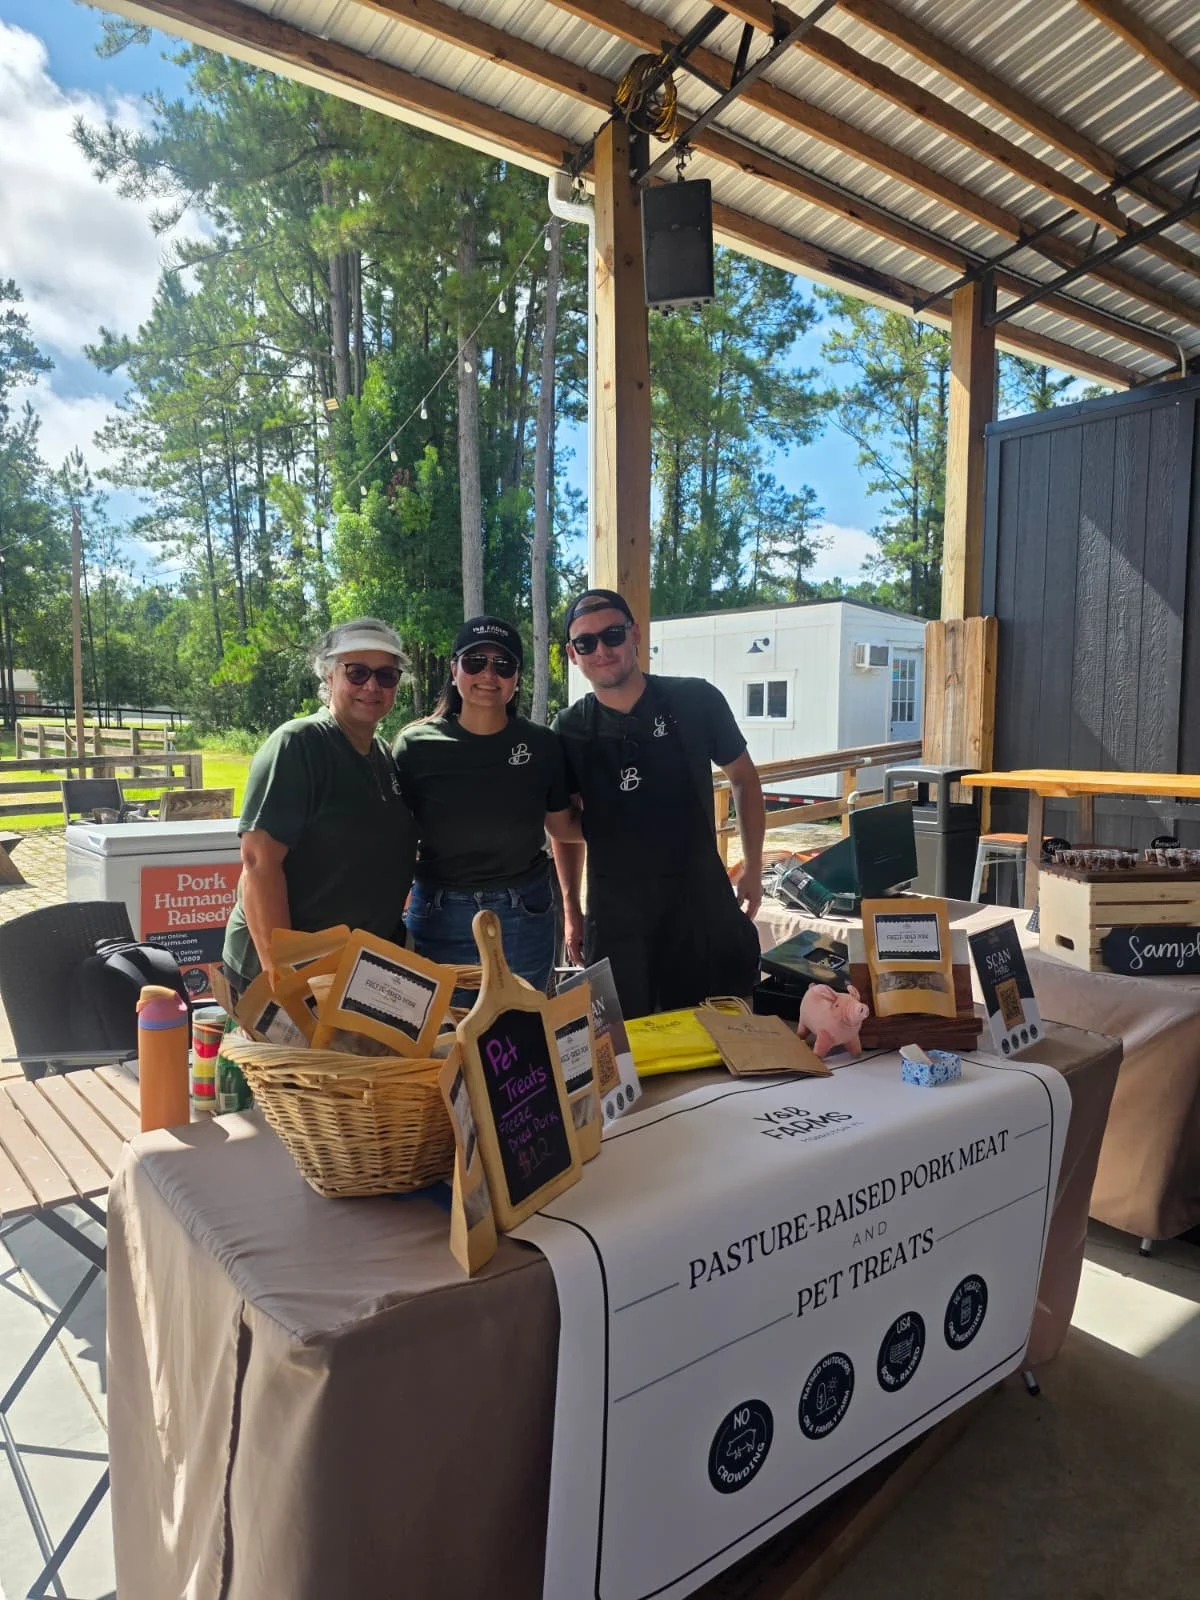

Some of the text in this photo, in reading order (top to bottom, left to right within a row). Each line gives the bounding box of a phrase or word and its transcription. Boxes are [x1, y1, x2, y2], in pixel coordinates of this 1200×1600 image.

[177, 872, 226, 891] Pork
[154, 889, 237, 909] Humanel
[986, 948, 1011, 969] SCAN
[486, 1035, 518, 1077] Pet
[499, 1064, 547, 1103] Treats
[760, 1111, 852, 1140] FARMS
[688, 1130, 1009, 1290] PASTURE-RAISED PORK MEAT
[852, 1221, 888, 1248] AND
[796, 1227, 935, 1318] PET TREATS
[896, 1315, 911, 1334] USA
[802, 1366, 822, 1400] RAISED
[733, 1408, 750, 1431] NO
[717, 1442, 765, 1484] CROWDING
